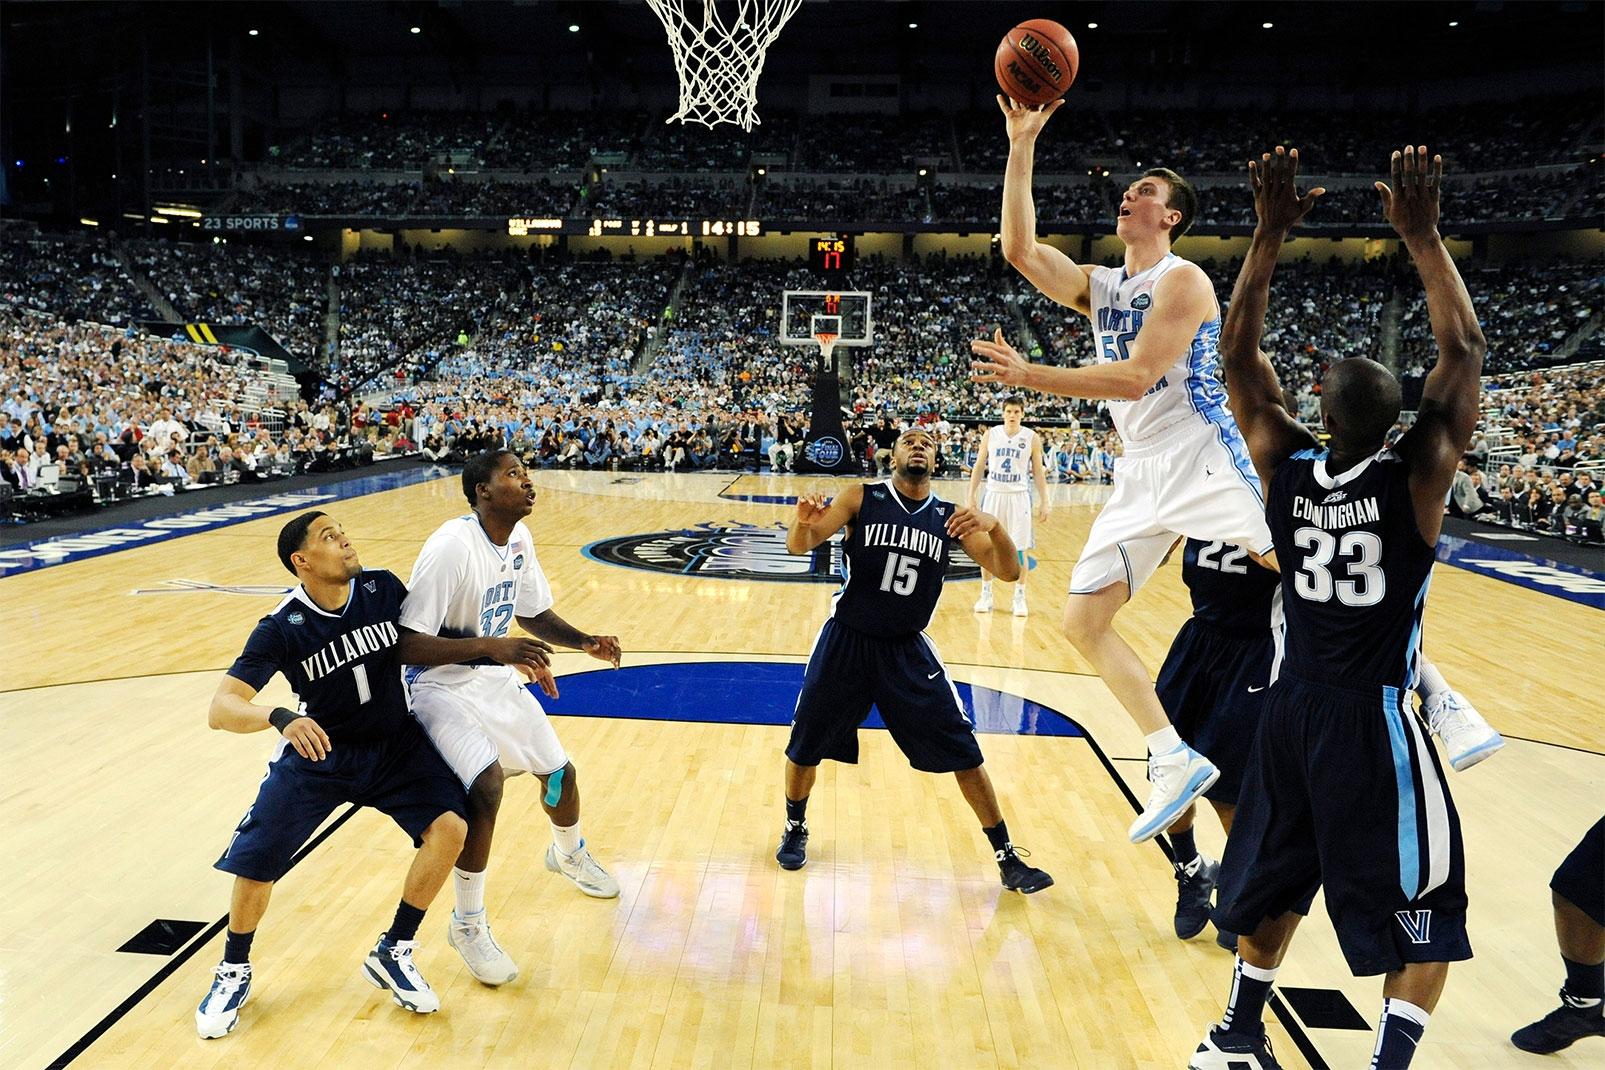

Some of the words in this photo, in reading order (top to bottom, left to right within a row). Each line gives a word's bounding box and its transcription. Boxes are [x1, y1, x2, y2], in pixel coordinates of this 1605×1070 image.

[1019, 33, 1062, 84] Wilson
[204, 218, 221, 229] 23
[226, 217, 279, 229] SPORTS
[702, 220, 760, 236] 14:15
[825, 252, 840, 269] 17
[996, 447, 1021, 459] NORTH
[1001, 458, 1011, 473] 4
[991, 471, 1021, 483] CAROLINA
[864, 523, 943, 563] VILLANOVA
[1197, 540, 1248, 575] 22
[879, 551, 921, 596] 15
[1293, 526, 1386, 607] 33
[480, 580, 517, 610] ORT
[300, 620, 399, 682] VILLANOVA
[351, 663, 372, 705] 1
[1394, 909, 1433, 945] V
